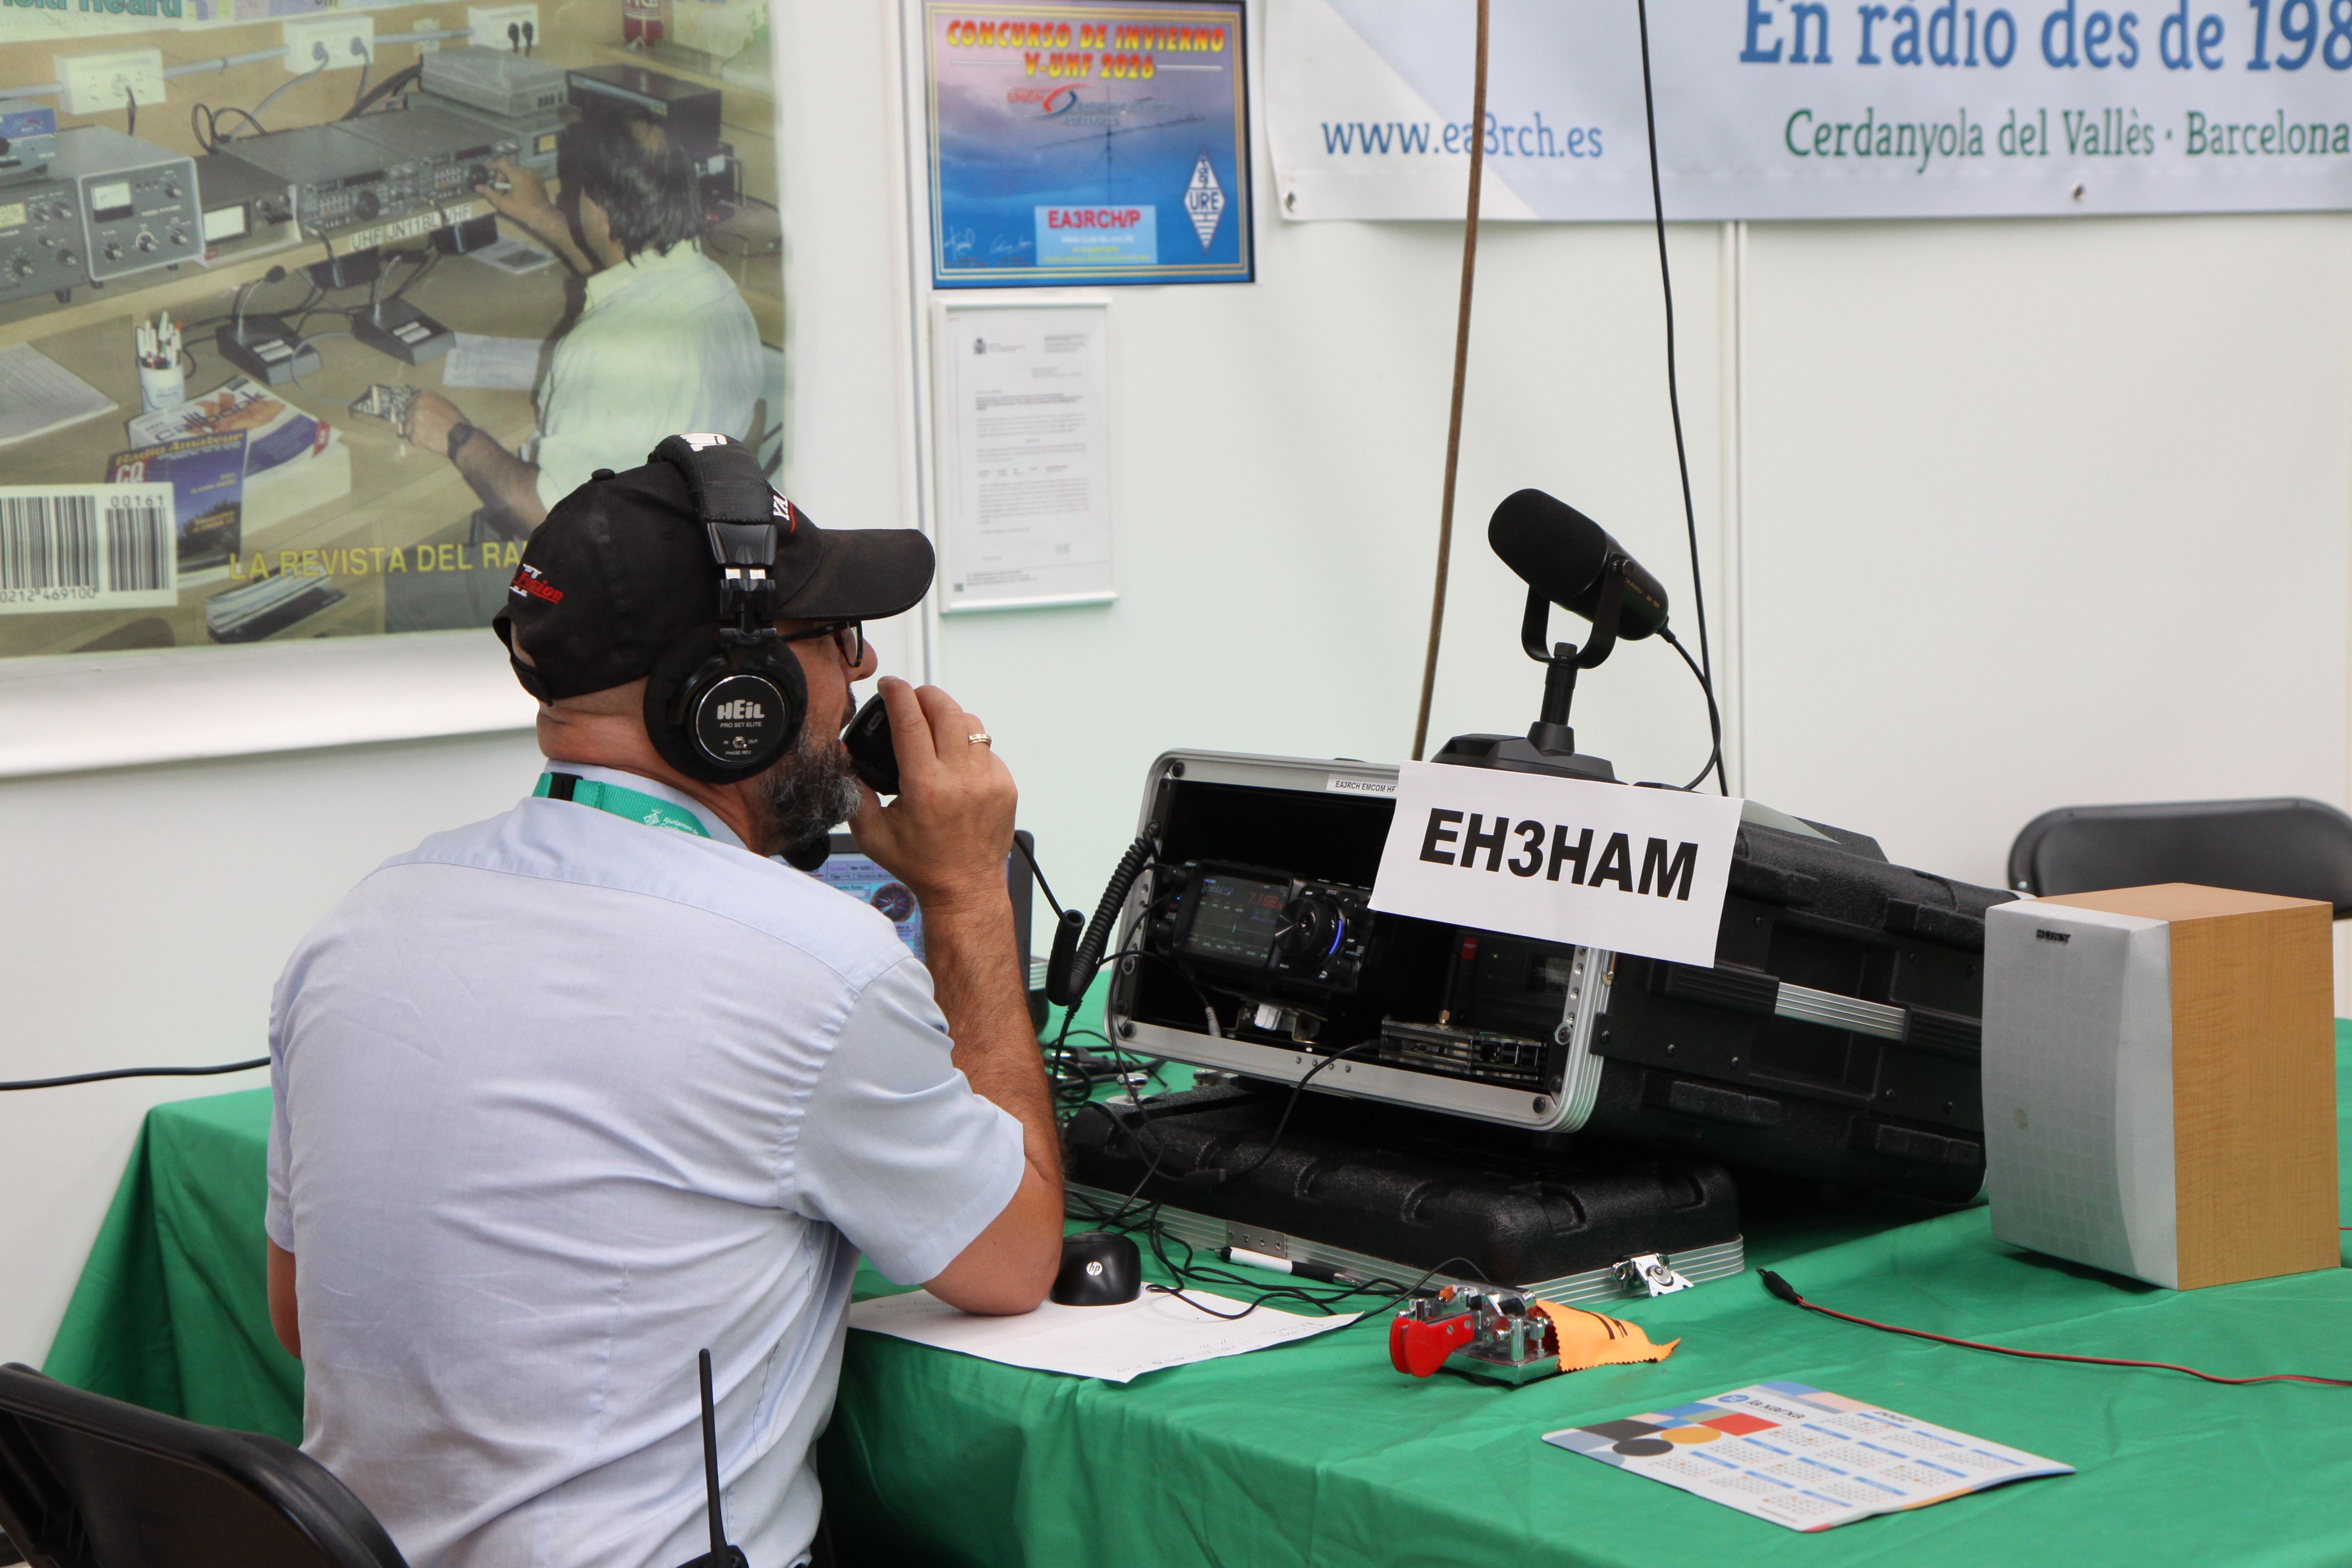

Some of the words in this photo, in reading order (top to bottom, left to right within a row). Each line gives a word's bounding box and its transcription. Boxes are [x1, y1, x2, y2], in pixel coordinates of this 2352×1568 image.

[946, 20, 1072, 49] CONCURSO
[1079, 24, 1106, 49] DE
[1115, 25, 1226, 53] INVIERNO
[1739, 0, 1832, 64] En
[2041, 0, 2140, 69] des
[2159, 0, 2226, 70] de
[1024, 51, 1092, 78] V-UHF
[1099, 52, 1156, 80] 2026
[1321, 111, 1604, 158] www.ea3rch.es
[1785, 107, 1985, 175] Cerdanyola
[1998, 107, 2050, 156] del
[2062, 108, 2155, 156] Vallès
[2185, 110, 2351, 155] Barcelona
[1190, 191, 1221, 210] URE
[351, 229, 382, 248] UHF
[388, 212, 440, 240] JN11BL
[1048, 209, 1141, 229] EA3RCH/P
[154, 391, 266, 441] callbook
[111, 495, 164, 508] 00161
[229, 552, 270, 581] LA
[279, 545, 408, 578] REVISTA
[416, 543, 474, 573] DEL
[482, 540, 528, 569] RA
[1335, 780, 1361, 790] EA3RCH
[1362, 783, 1386, 792] EMCOM
[1419, 807, 1699, 901] EH3HAM
[2036, 929, 2071, 943] SONY
[1088, 1262, 1101, 1275] hp
